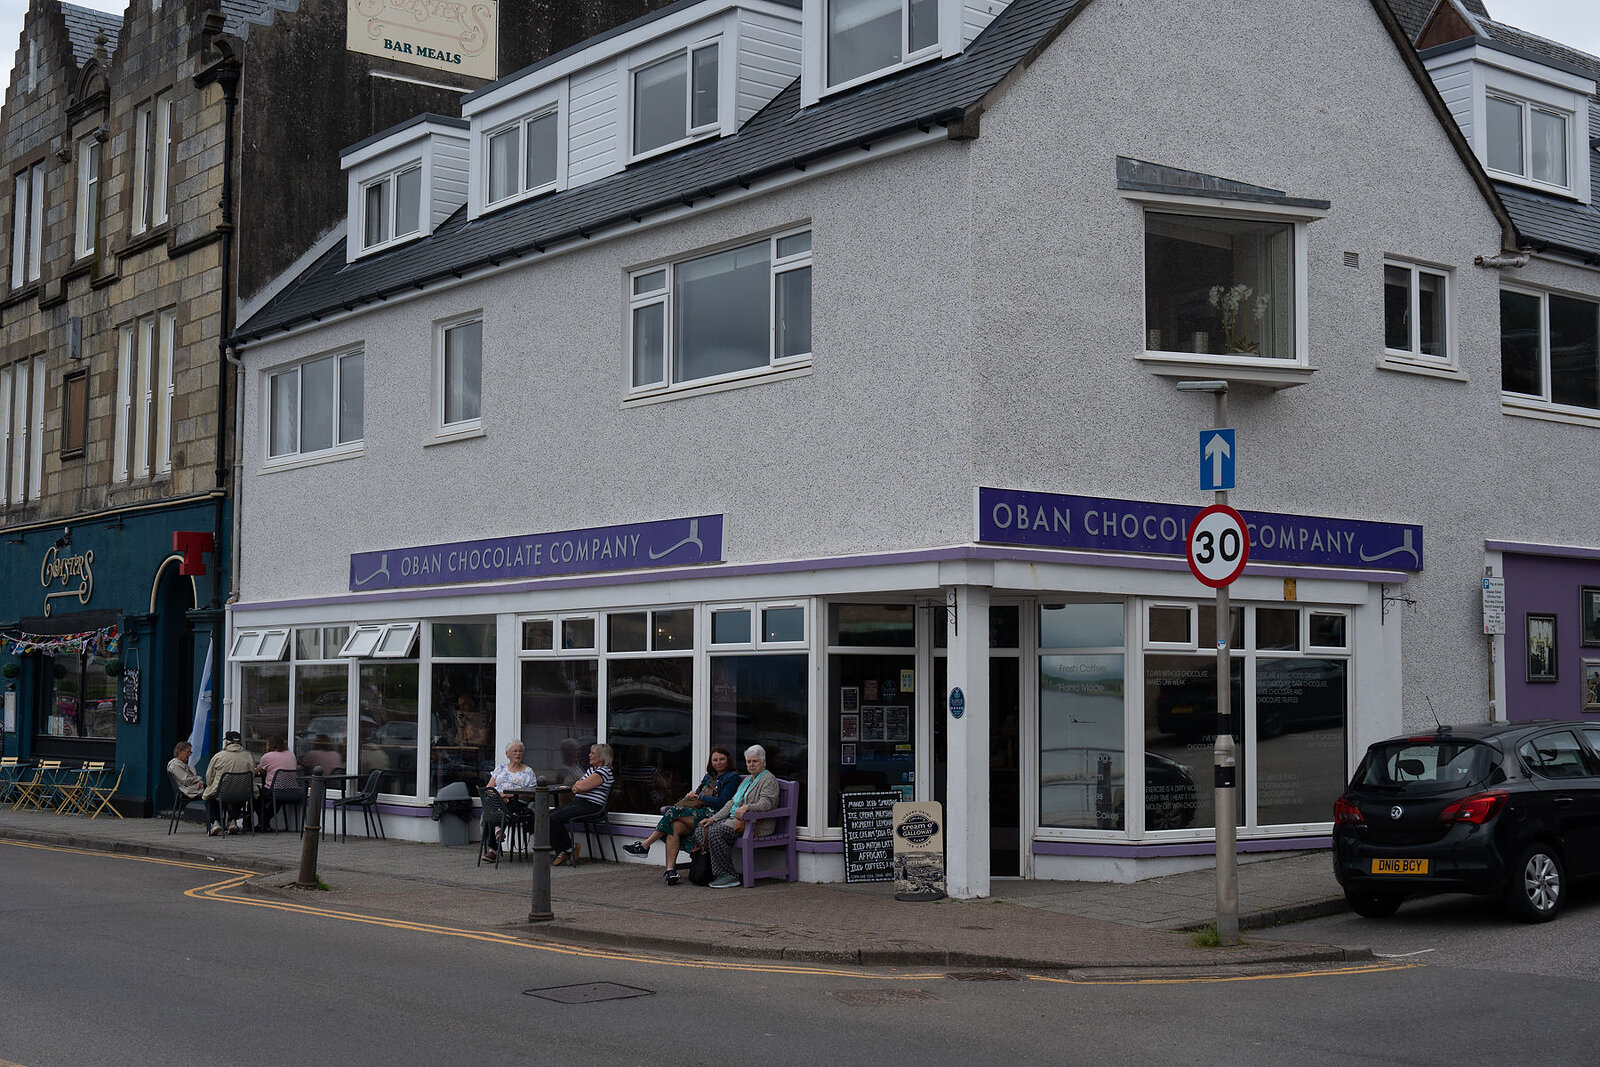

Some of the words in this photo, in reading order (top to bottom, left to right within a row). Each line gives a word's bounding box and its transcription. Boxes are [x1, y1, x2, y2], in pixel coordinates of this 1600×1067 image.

[383, 38, 413, 55] BAR
[416, 45, 463, 65] MEALS
[992, 502, 1072, 535] OBAN
[1084, 510, 1187, 542] CHOCOL
[400, 552, 442, 577] OBAN
[448, 543, 543, 572] CHOCOLATE
[550, 533, 641, 563] COMPANY
[1195, 527, 1240, 564] 30
[902, 823, 926, 831] cream
[902, 829, 933, 837] GALLOWAY
[1379, 860, 1400, 871] DN16
